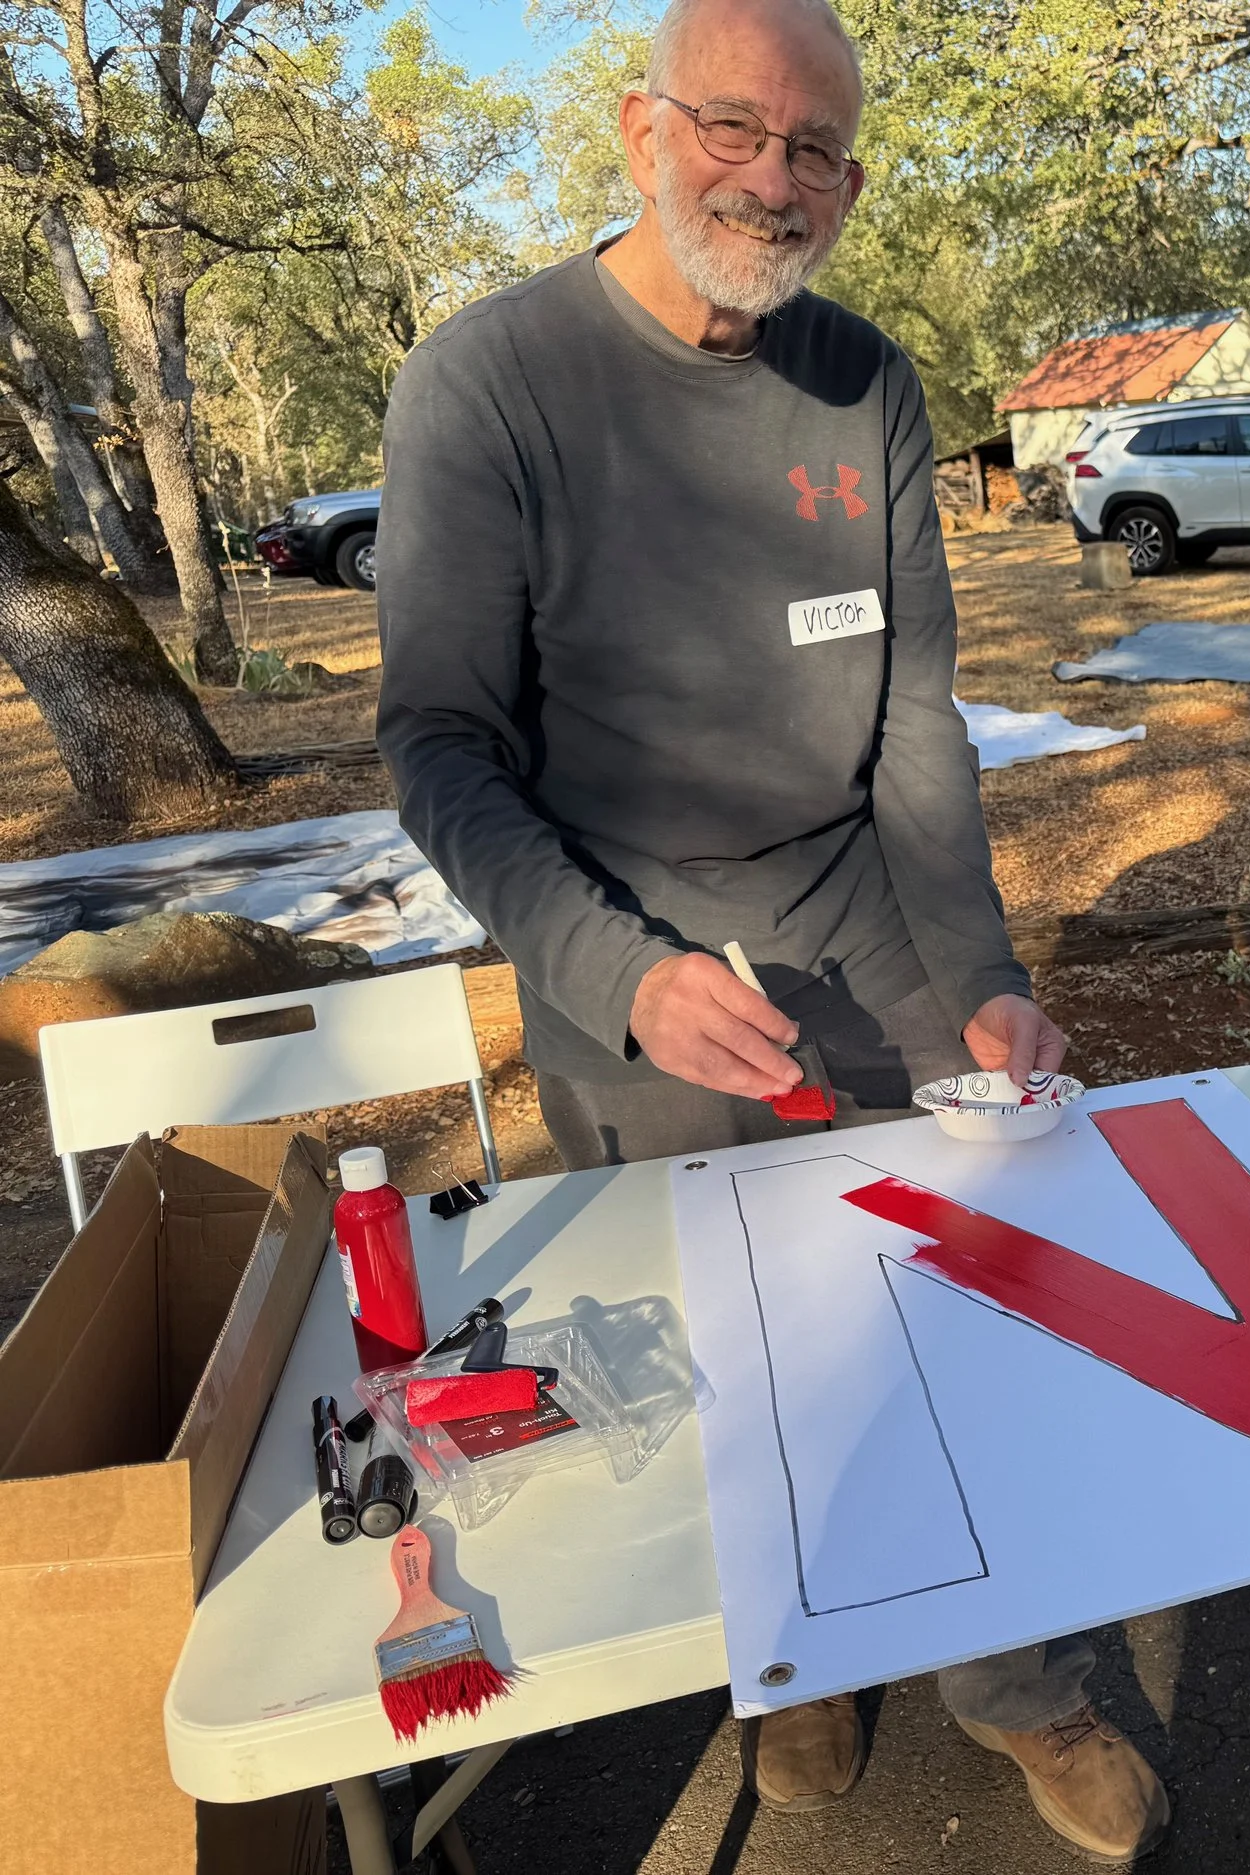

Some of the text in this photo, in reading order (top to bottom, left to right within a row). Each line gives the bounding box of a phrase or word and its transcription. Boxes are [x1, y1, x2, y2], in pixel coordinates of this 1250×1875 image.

[544, 1407, 558, 1416] Kit
[518, 1412, 563, 1428] Touch-Up
[489, 1426, 505, 1437] 3
